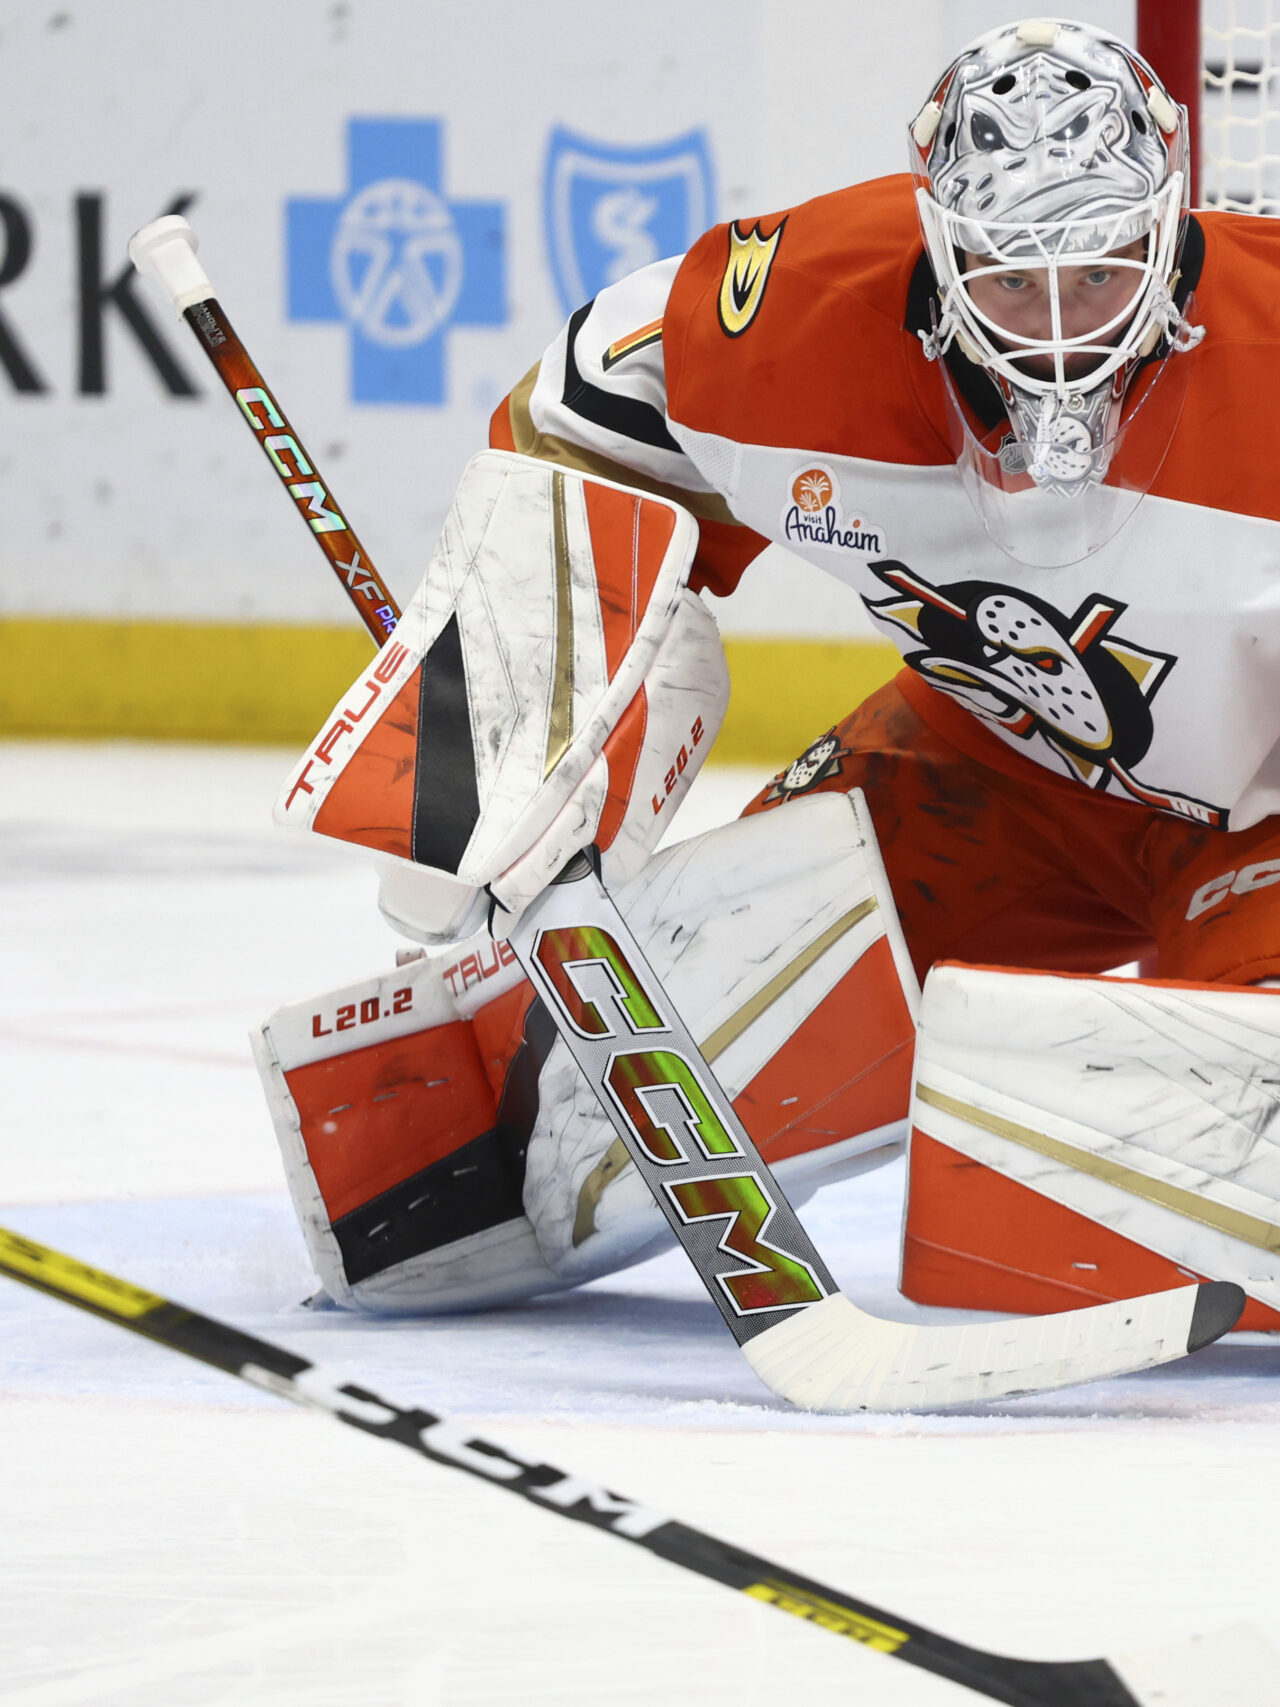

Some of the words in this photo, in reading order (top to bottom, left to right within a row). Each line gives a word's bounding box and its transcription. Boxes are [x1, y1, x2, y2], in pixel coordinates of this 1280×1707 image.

[236, 387, 348, 533] CCM
[785, 505, 881, 554] Anaheim
[803, 514, 823, 525] visit
[334, 550, 386, 603] XF
[285, 641, 411, 811] TRUE
[651, 715, 705, 815] L20.2
[312, 986, 413, 1038] L20.2
[530, 925, 829, 1317] CCM
